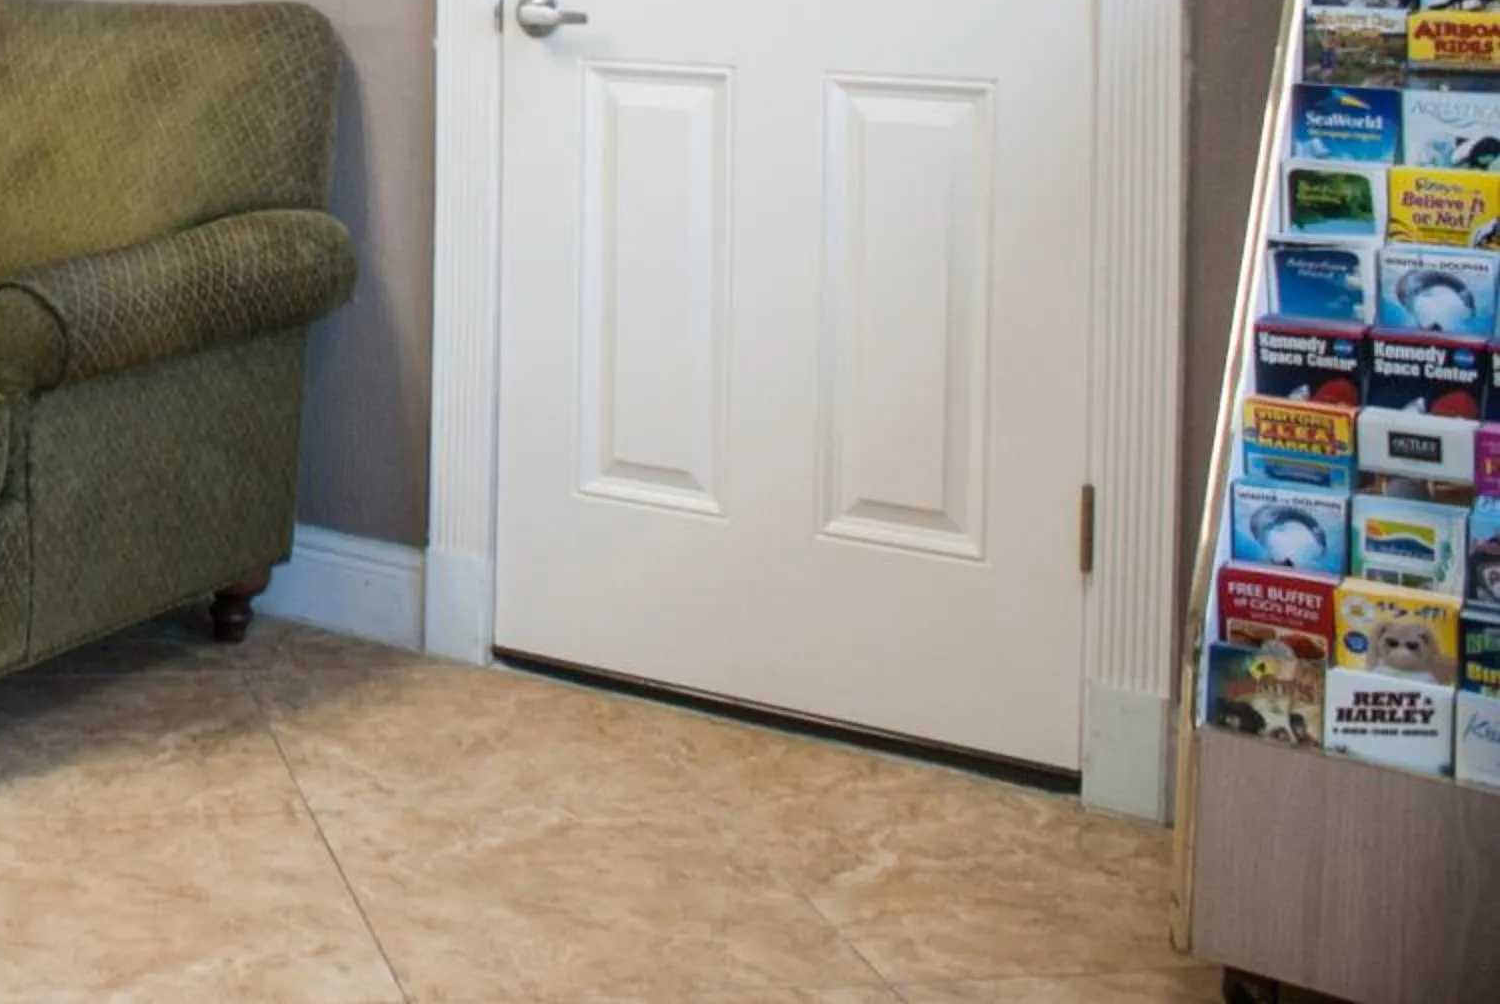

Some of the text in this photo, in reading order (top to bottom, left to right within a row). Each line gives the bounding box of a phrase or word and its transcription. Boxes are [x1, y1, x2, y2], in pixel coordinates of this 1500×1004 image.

[1434, 39, 1493, 54] RIDES
[1305, 110, 1384, 129] SeaWorld
[1402, 190, 1486, 213] Believe It
[1411, 211, 1474, 229] or Not!
[1258, 331, 1327, 356] Kennedy
[1373, 340, 1448, 365] Kennedy
[1259, 348, 1358, 372] Space Center
[1373, 359, 1422, 377] Space
[1425, 363, 1479, 383] Center
[1391, 437, 1437, 453] OUTLET
[1227, 581, 1324, 609] FREE BUFFET
[1352, 691, 1421, 707] RENT
[1335, 707, 1436, 725] HARLEY
